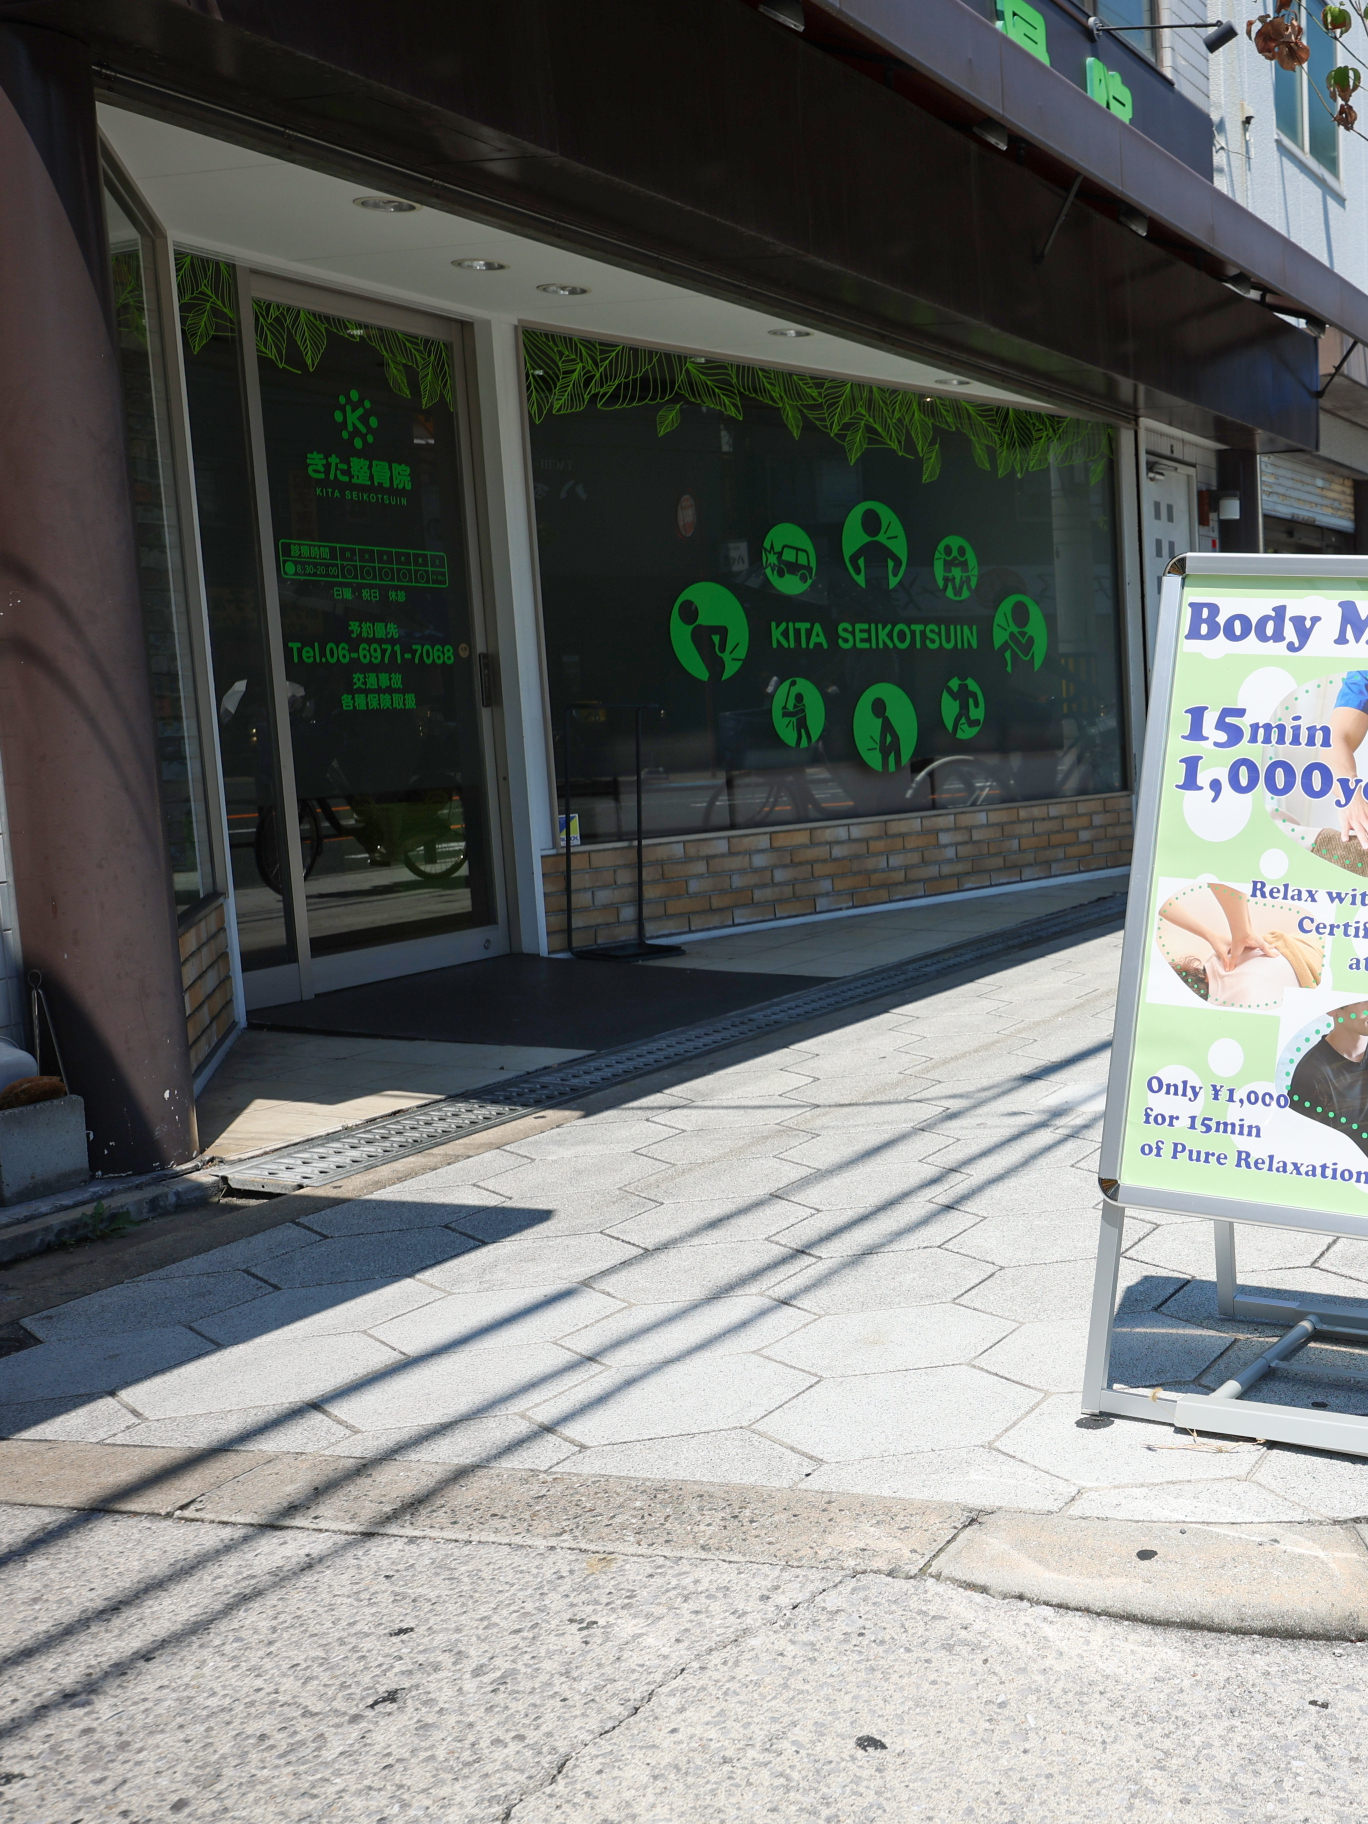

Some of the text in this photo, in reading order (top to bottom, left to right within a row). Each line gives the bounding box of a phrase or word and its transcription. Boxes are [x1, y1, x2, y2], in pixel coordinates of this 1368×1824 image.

[306, 451, 412, 490] きた整骨院
[316, 487, 407, 506] KITA SEIKOTSUIN
[290, 544, 330, 560] 診療時間
[296, 564, 338, 576] 8:30-20:00
[388, 590, 406, 602] 休診
[348, 621, 399, 639] 予約優先
[771, 621, 978, 650] KITA SEIKOTSUIN
[1185, 601, 1322, 653] Body
[288, 641, 455, 665] Tel.06-6971-7068
[352, 672, 403, 689] 交通事故
[341, 693, 417, 711] 各種保険取扱
[1181, 705, 1332, 749] 15min
[1250, 880, 1319, 903] Relax
[1146, 1075, 1289, 1109] Only ¥1,000
[1143, 1107, 1261, 1139] for 15min
[1140, 1140, 1164, 1158] of
[1171, 1142, 1228, 1166] Pure
